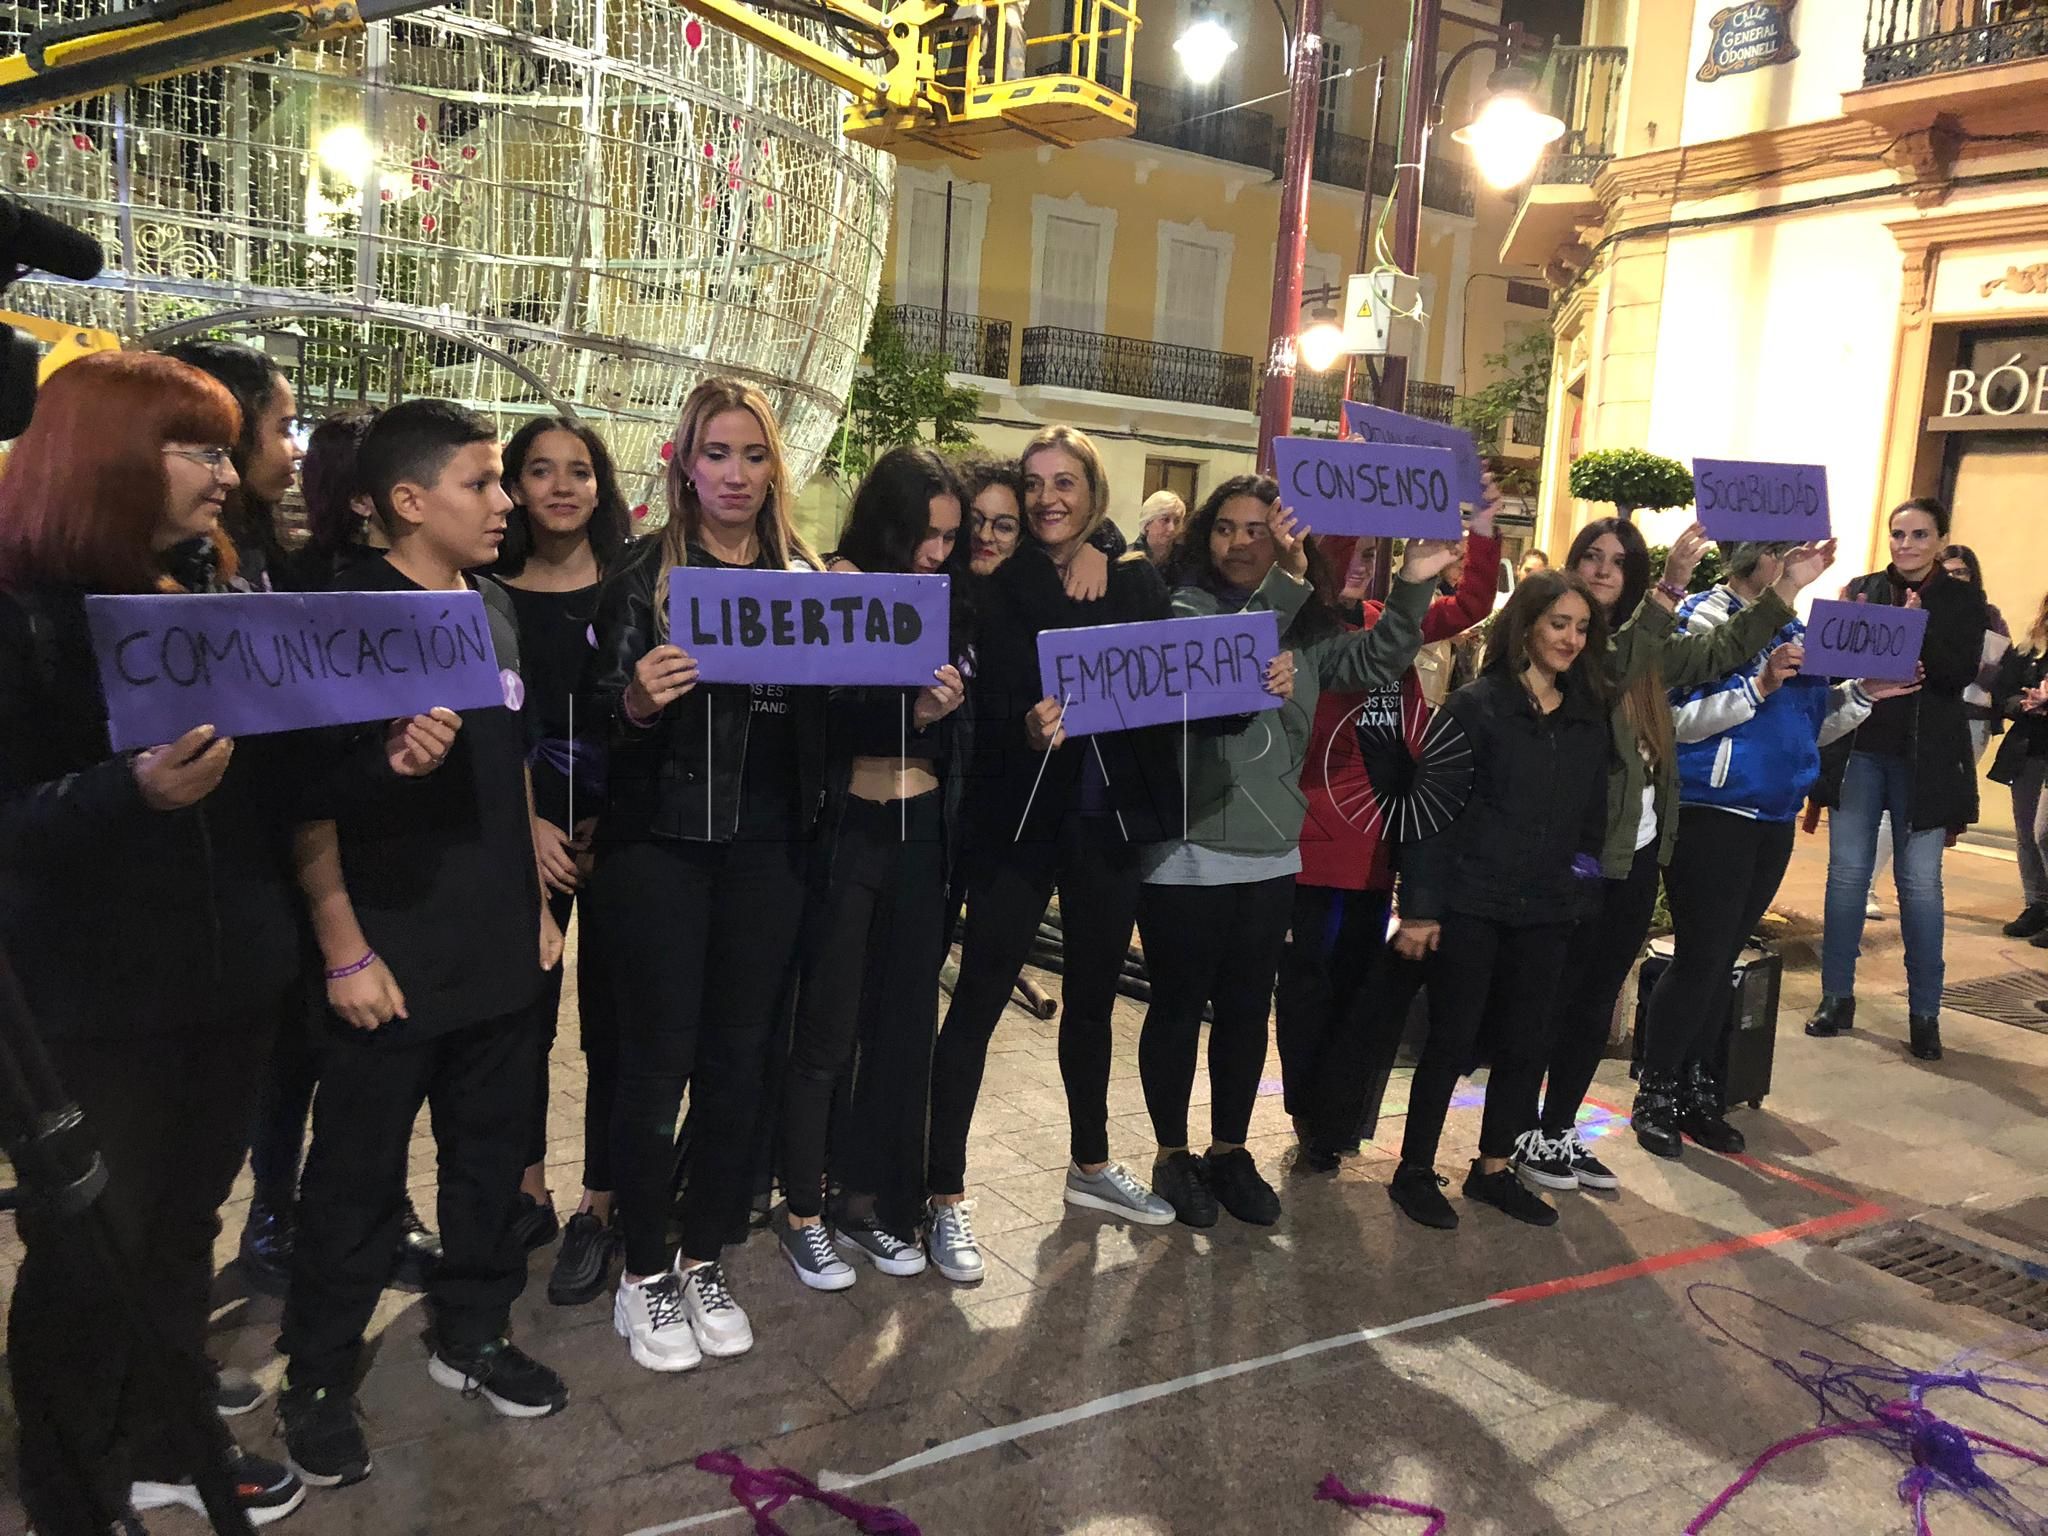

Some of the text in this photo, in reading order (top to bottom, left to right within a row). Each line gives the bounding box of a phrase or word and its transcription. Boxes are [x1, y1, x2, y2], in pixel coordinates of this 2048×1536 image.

[1722, 23, 1778, 48] GENERAL
[1733, 6, 1769, 28] CALLE
[1292, 458, 1449, 513] CONSENSO
[690, 596, 923, 648] LIBERTAD
[1055, 632, 1265, 707] EMPODERAR
[750, 700, 789, 714] TAND
